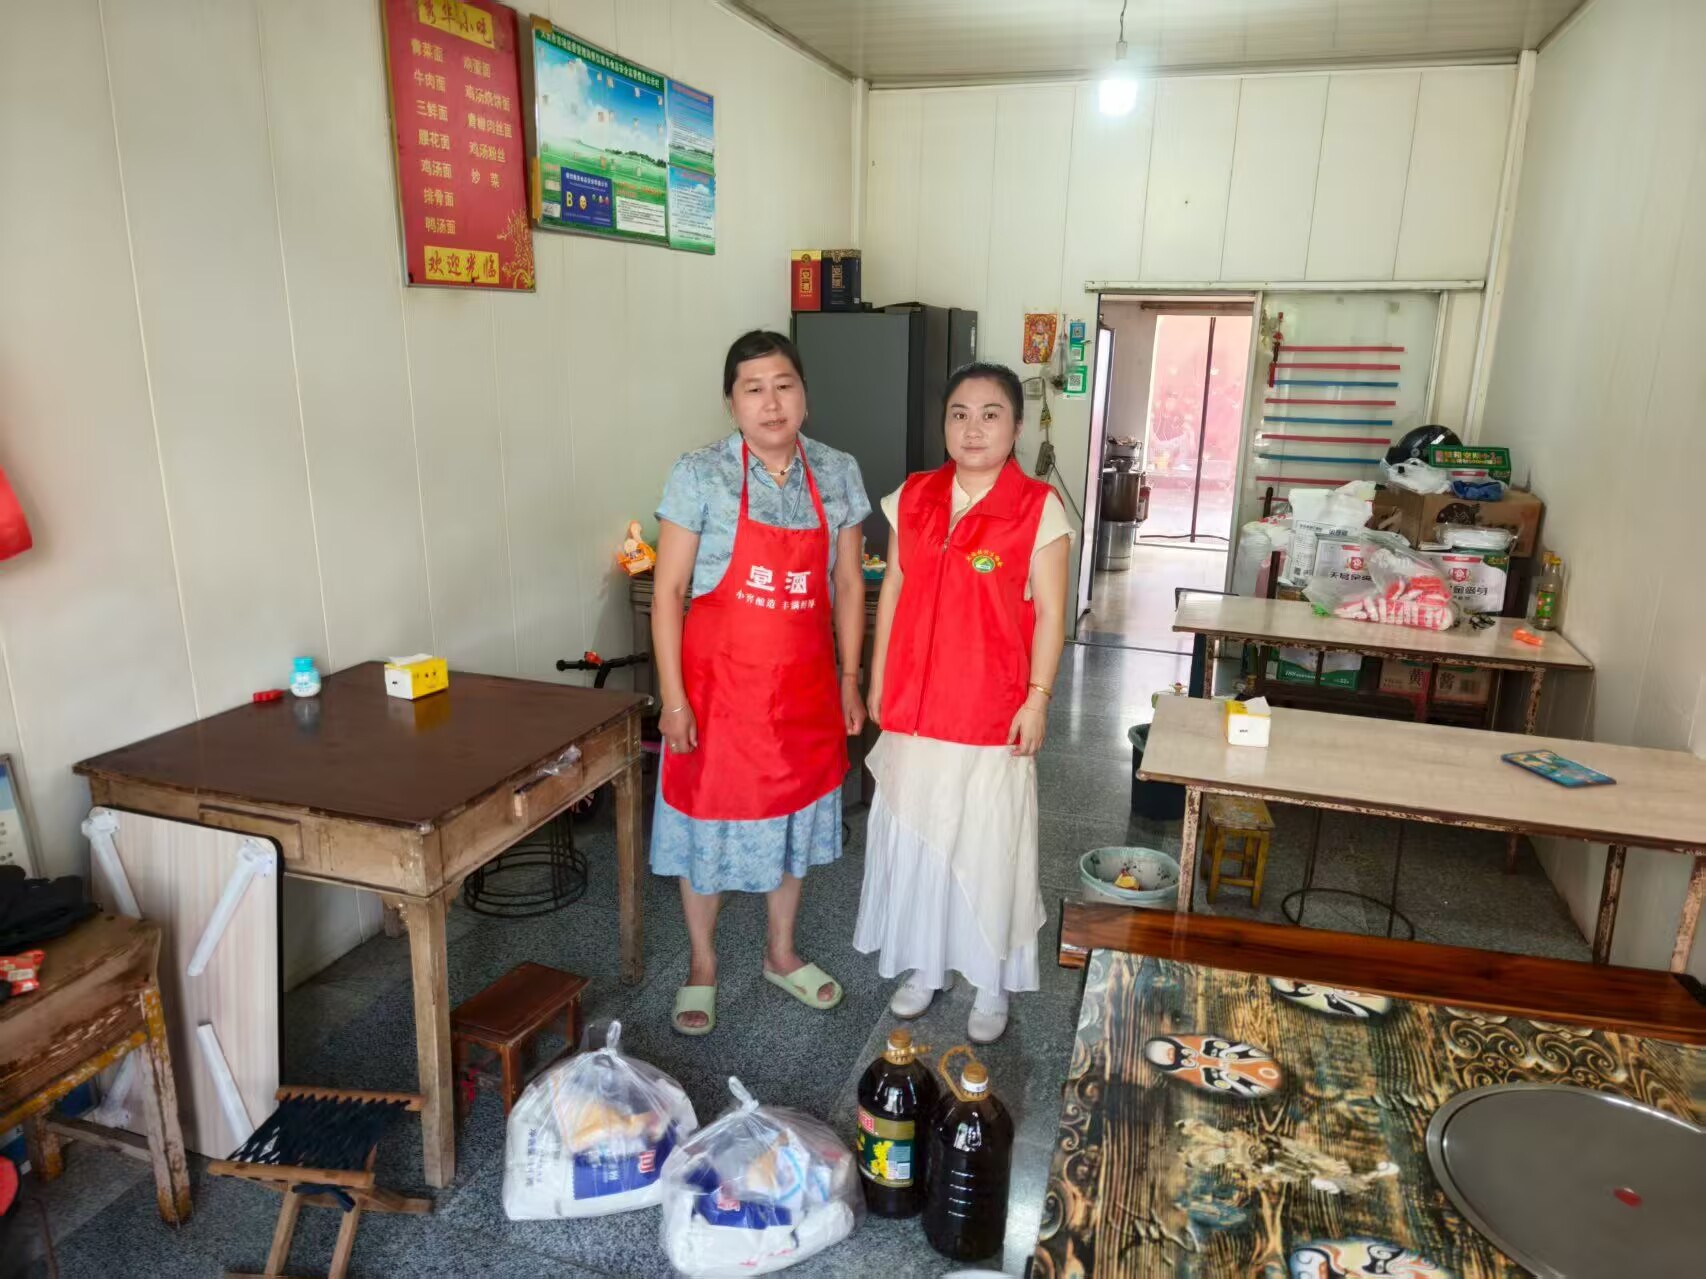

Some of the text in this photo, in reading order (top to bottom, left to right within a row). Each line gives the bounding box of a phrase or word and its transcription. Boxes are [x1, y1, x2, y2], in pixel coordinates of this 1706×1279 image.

[414, 69, 446, 93] 牛肉面
[416, 99, 448, 122] 三鲜面
[469, 141, 506, 163] 鸡汤粉丝
[421, 159, 452, 179] 鸡汤面
[423, 187, 454, 207] 排骨面
[567, 191, 574, 208] B
[425, 216, 456, 235] 鸭汤面
[428, 250, 497, 281] 欢迎光临
